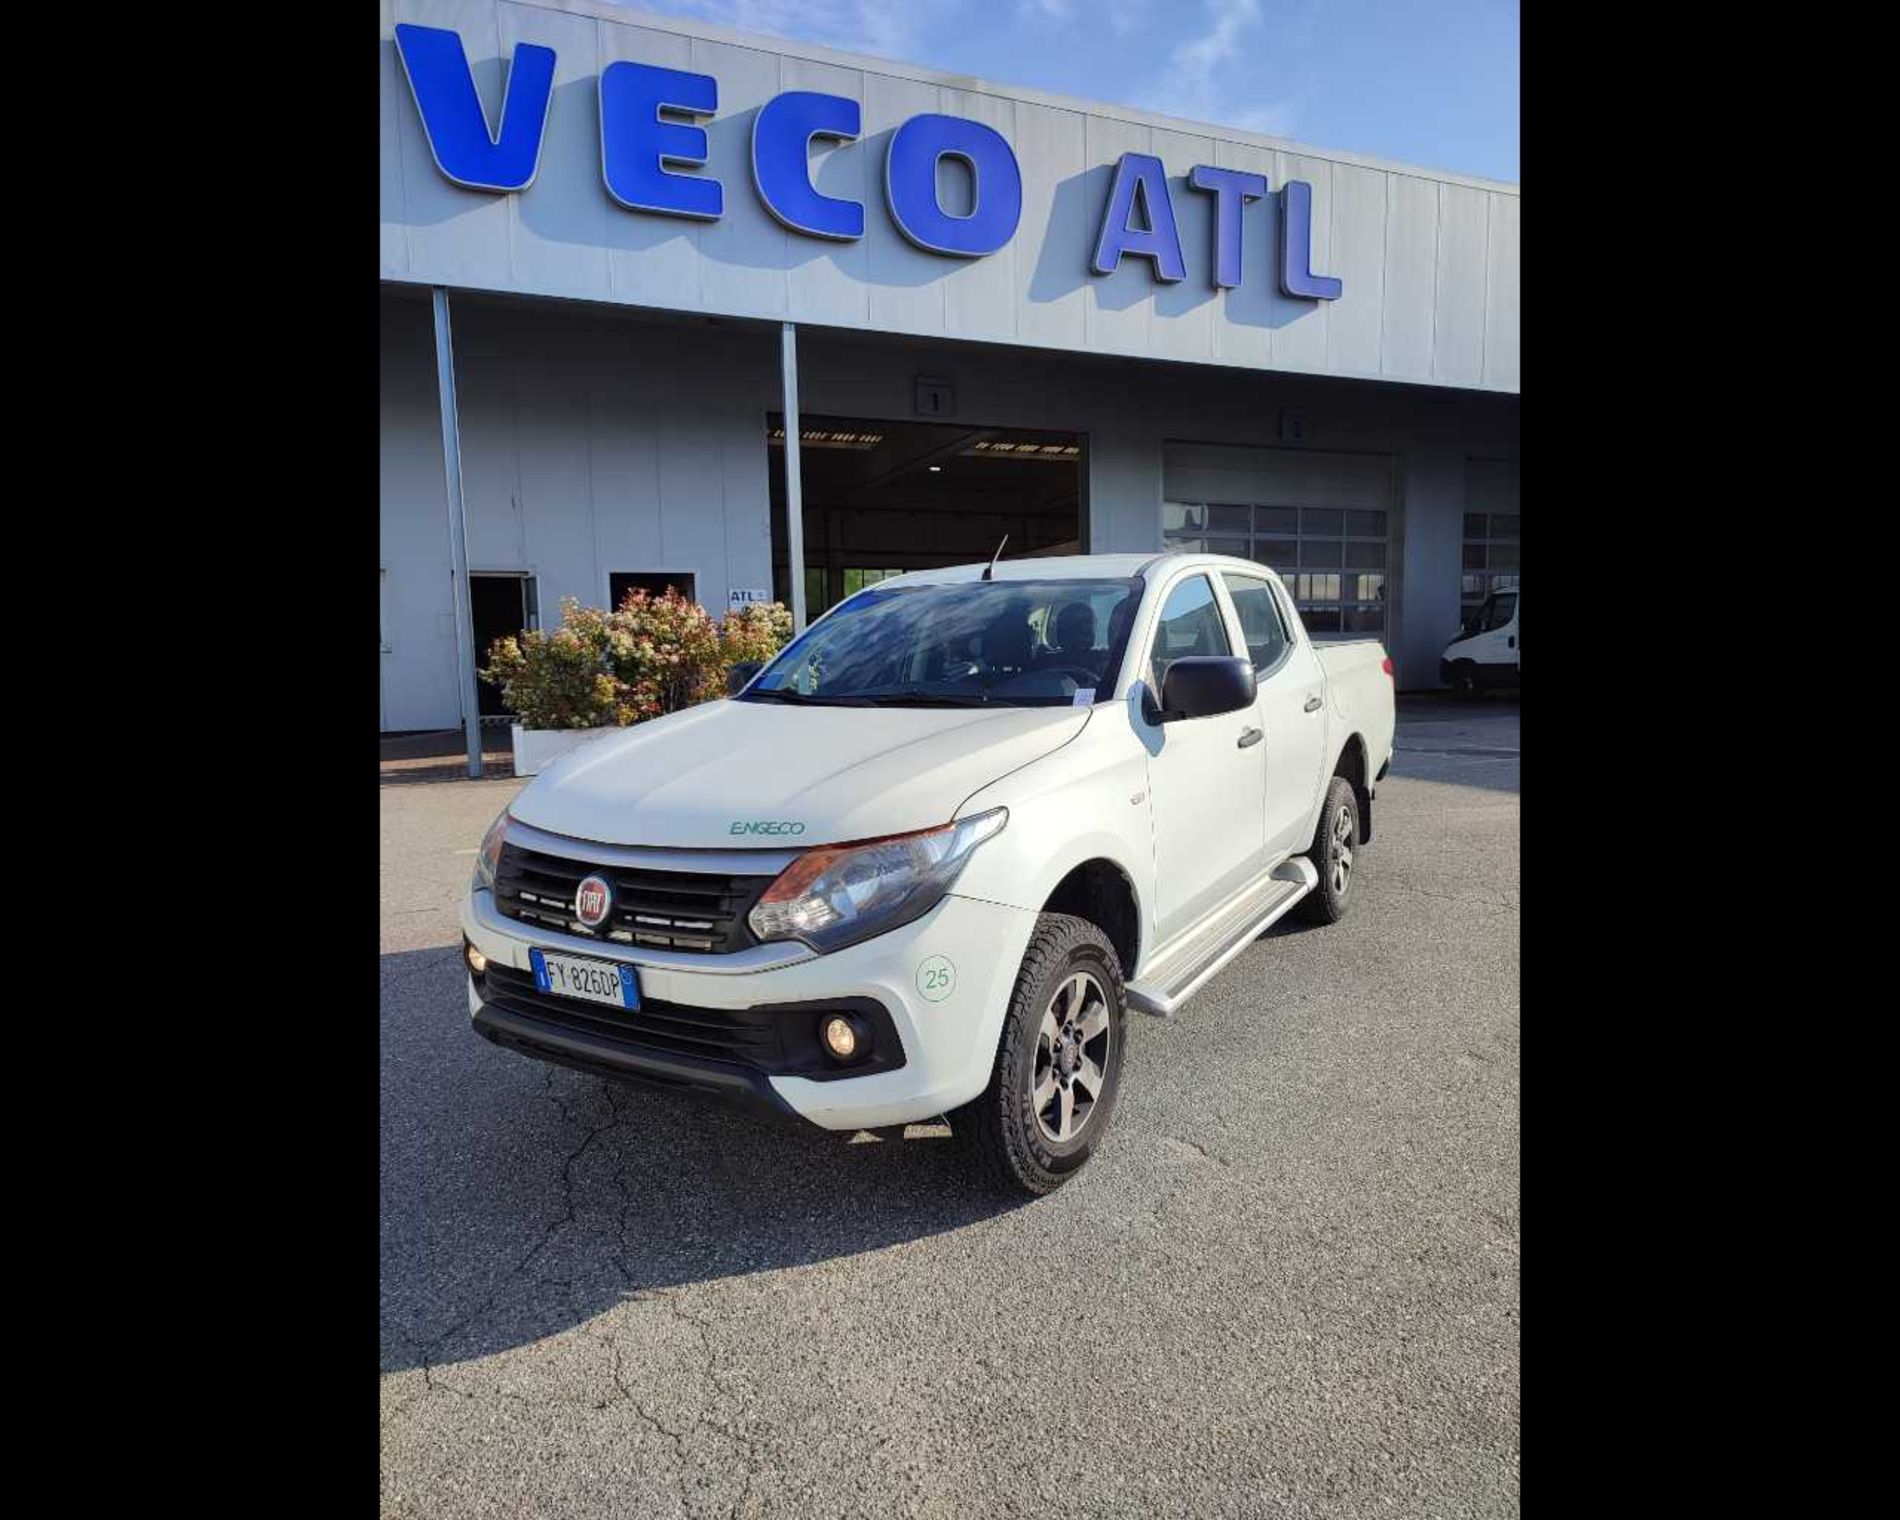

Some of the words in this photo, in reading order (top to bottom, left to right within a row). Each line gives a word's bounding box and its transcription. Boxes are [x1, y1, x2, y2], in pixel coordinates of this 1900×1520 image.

[394, 23, 1023, 258] VECO
[1089, 151, 1343, 302] ATL
[731, 591, 757, 602] ATL
[729, 821, 806, 835] ENGECO
[581, 890, 603, 913] FIAT
[925, 968, 950, 989] 25
